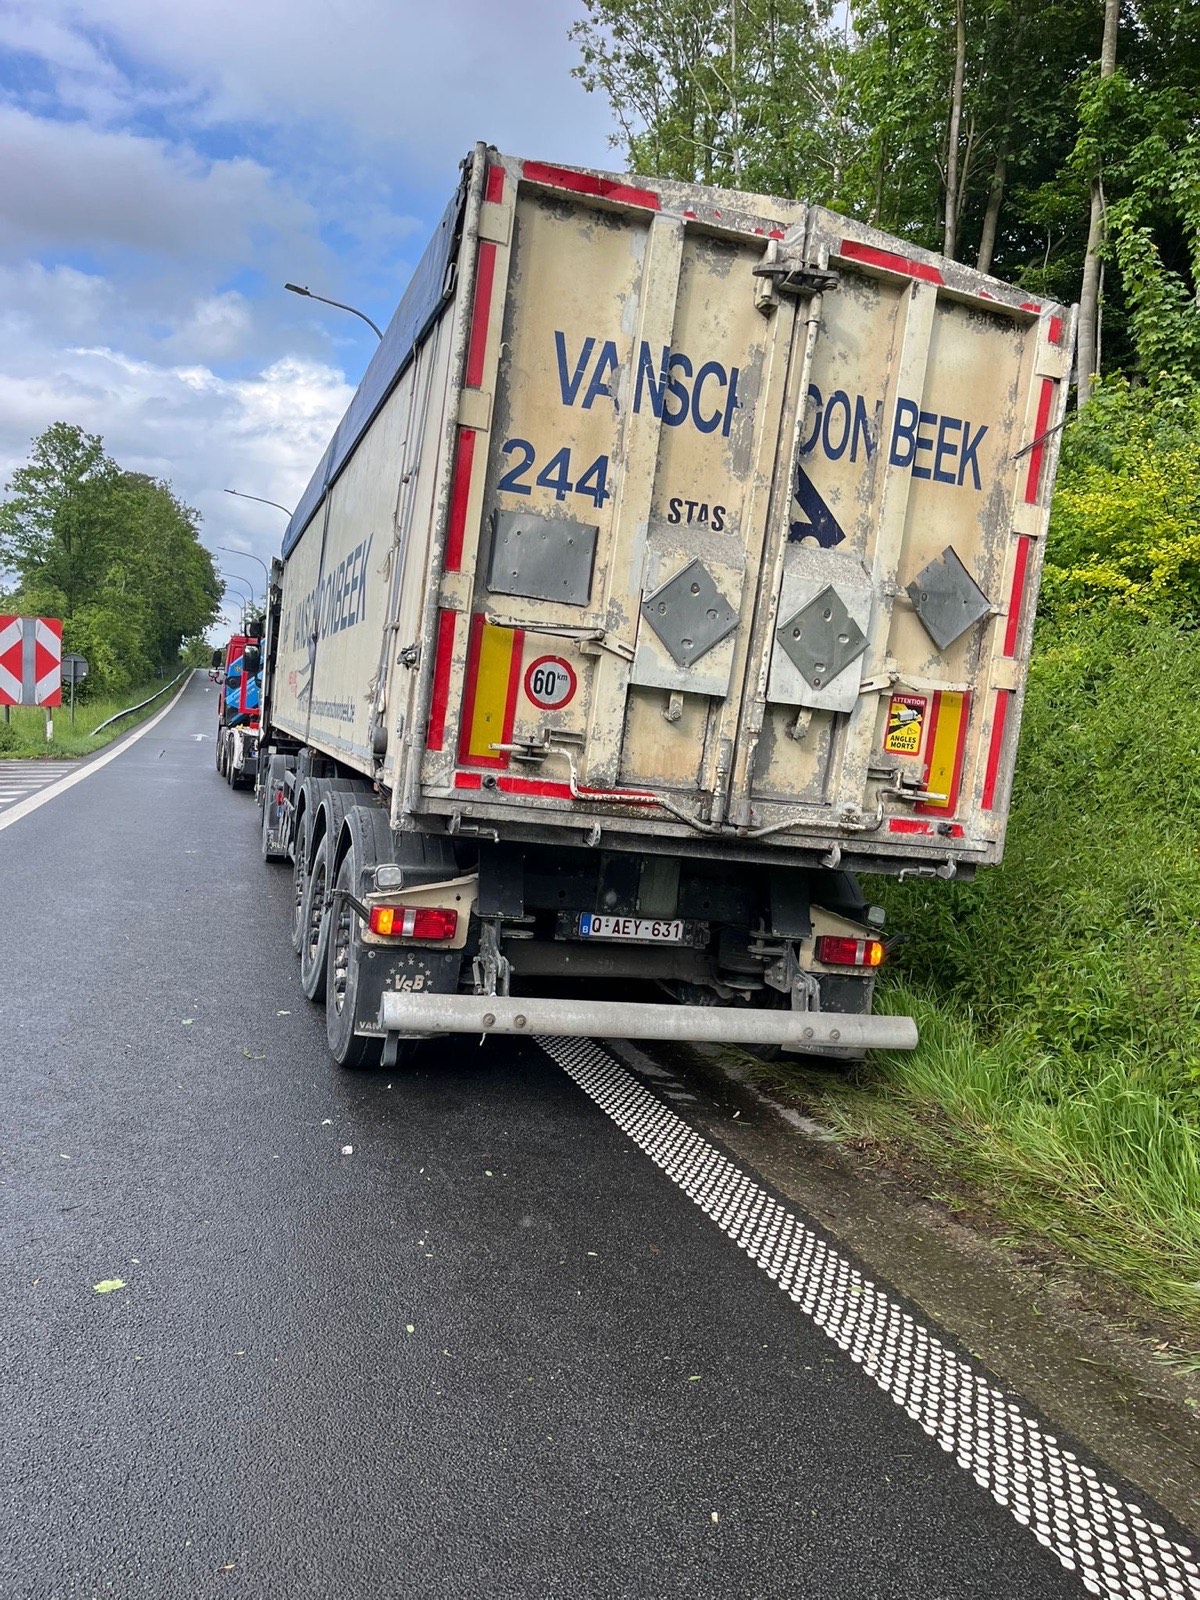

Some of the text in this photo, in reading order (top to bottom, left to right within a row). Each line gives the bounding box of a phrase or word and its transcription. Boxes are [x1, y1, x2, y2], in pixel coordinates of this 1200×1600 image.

[496, 438, 611, 509] 244
[667, 497, 726, 532] STAS
[533, 669, 567, 696] 60 km
[892, 697, 925, 705] ATTENTION
[890, 735, 915, 743] ANGLES
[592, 917, 680, 938] Q-AEY-631
